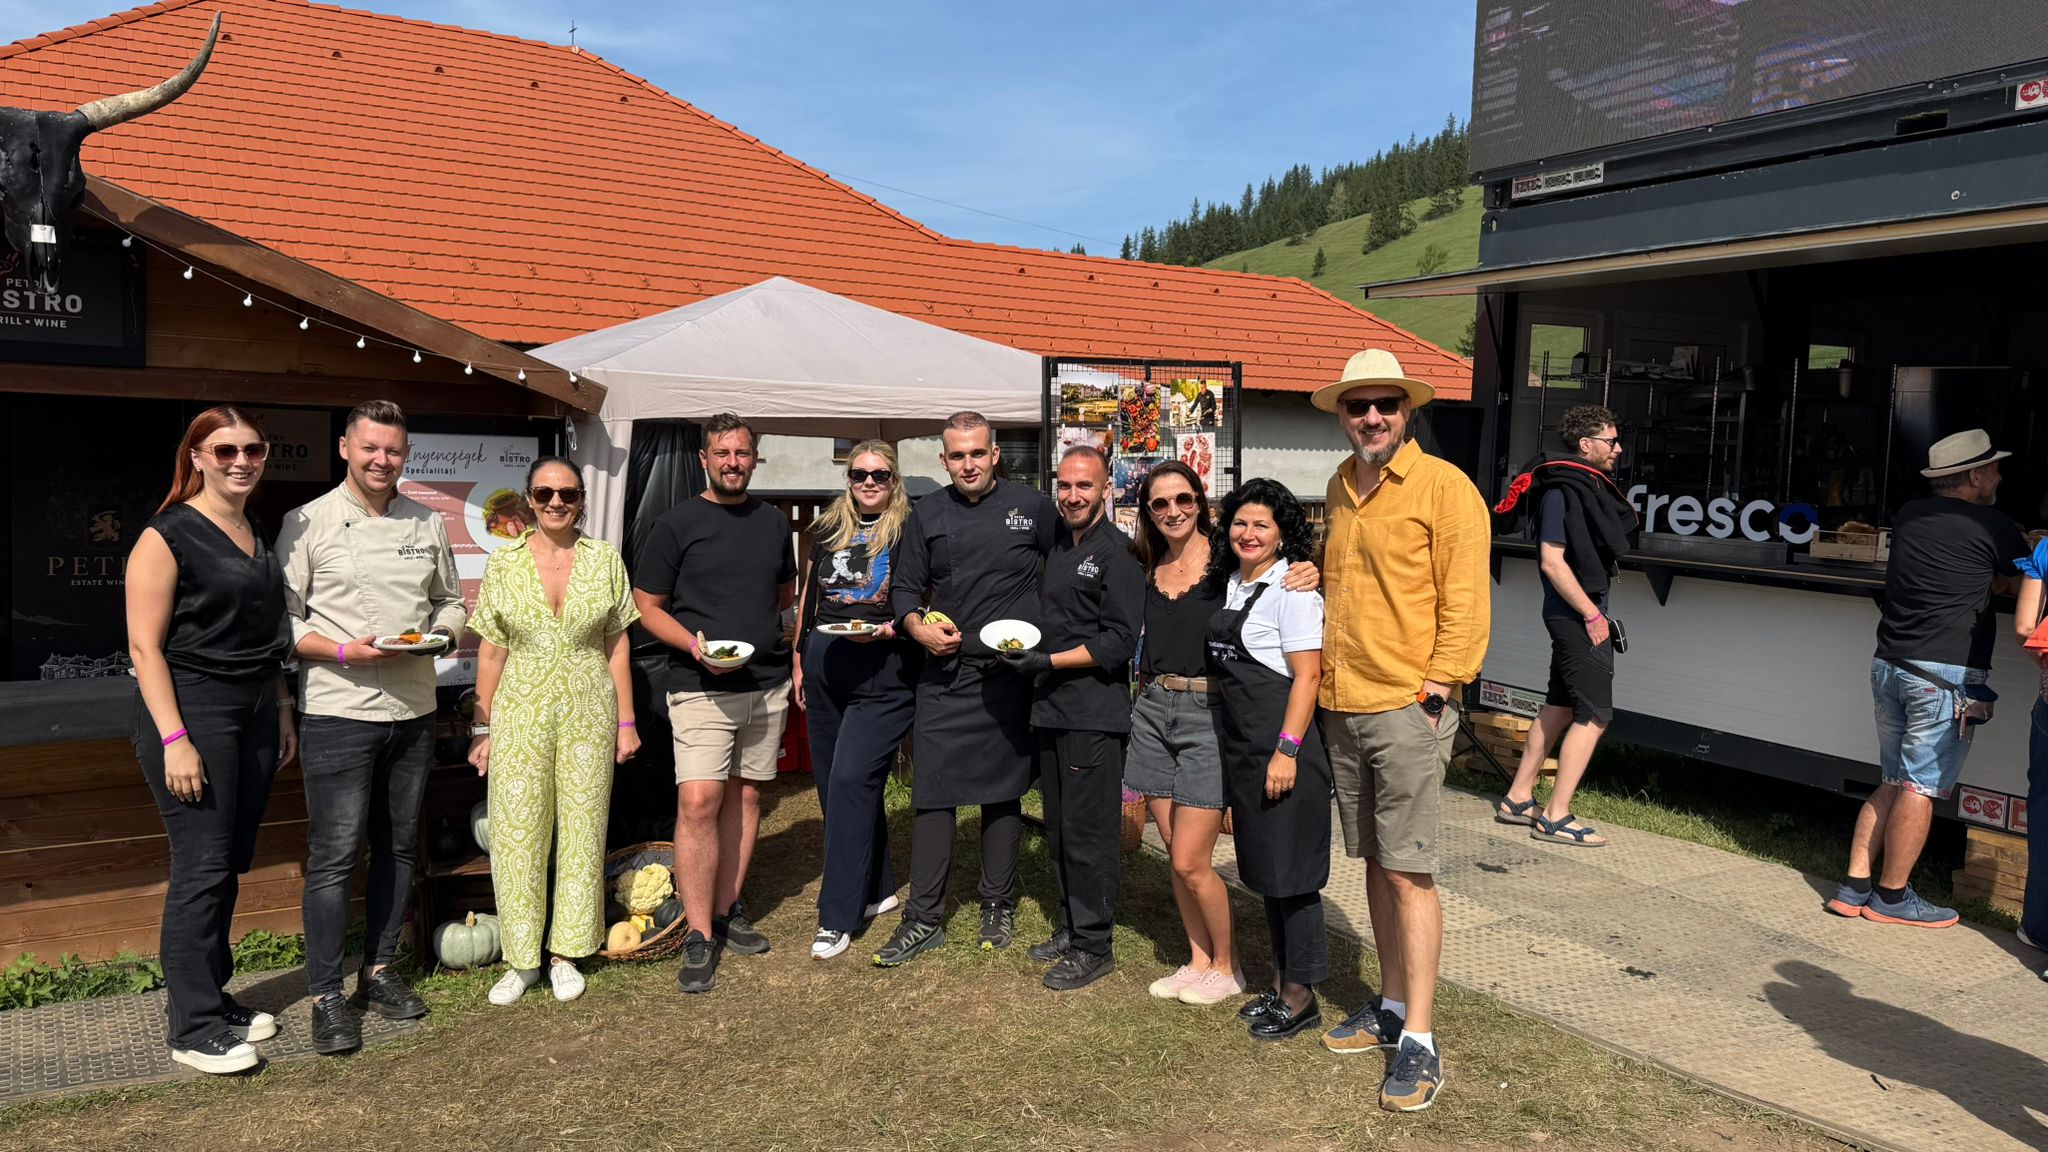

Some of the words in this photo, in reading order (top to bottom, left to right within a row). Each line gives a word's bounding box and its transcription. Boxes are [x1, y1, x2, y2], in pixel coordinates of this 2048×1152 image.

[33, 318, 68, 328] WINE
[499, 455, 531, 463] BISTRO
[1627, 484, 1820, 544] fresco
[397, 546, 425, 556] BISTRO
[47, 556, 127, 576] PET
